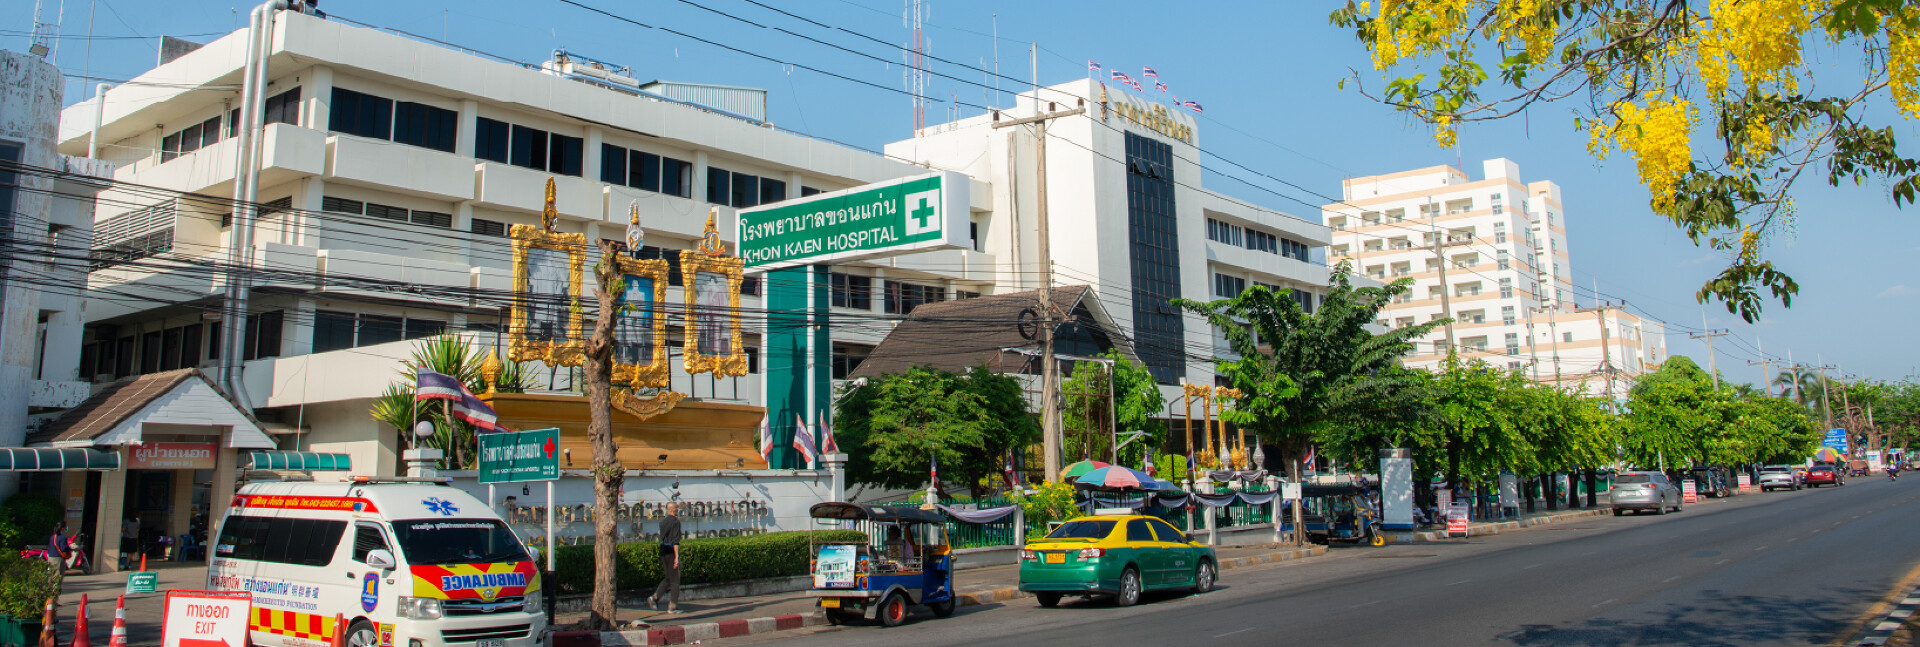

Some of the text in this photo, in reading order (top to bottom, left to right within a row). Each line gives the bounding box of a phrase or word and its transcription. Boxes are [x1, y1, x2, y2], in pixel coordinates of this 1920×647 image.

[740, 193, 897, 242] โรงพยาบาลขอนแก่น
[743, 225, 899, 264] KHON KAEN HOSPITAL
[135, 443, 210, 461] ผู้ป่วยนอก
[187, 604, 229, 618] ทางออก
[195, 621, 216, 635] EXIT
